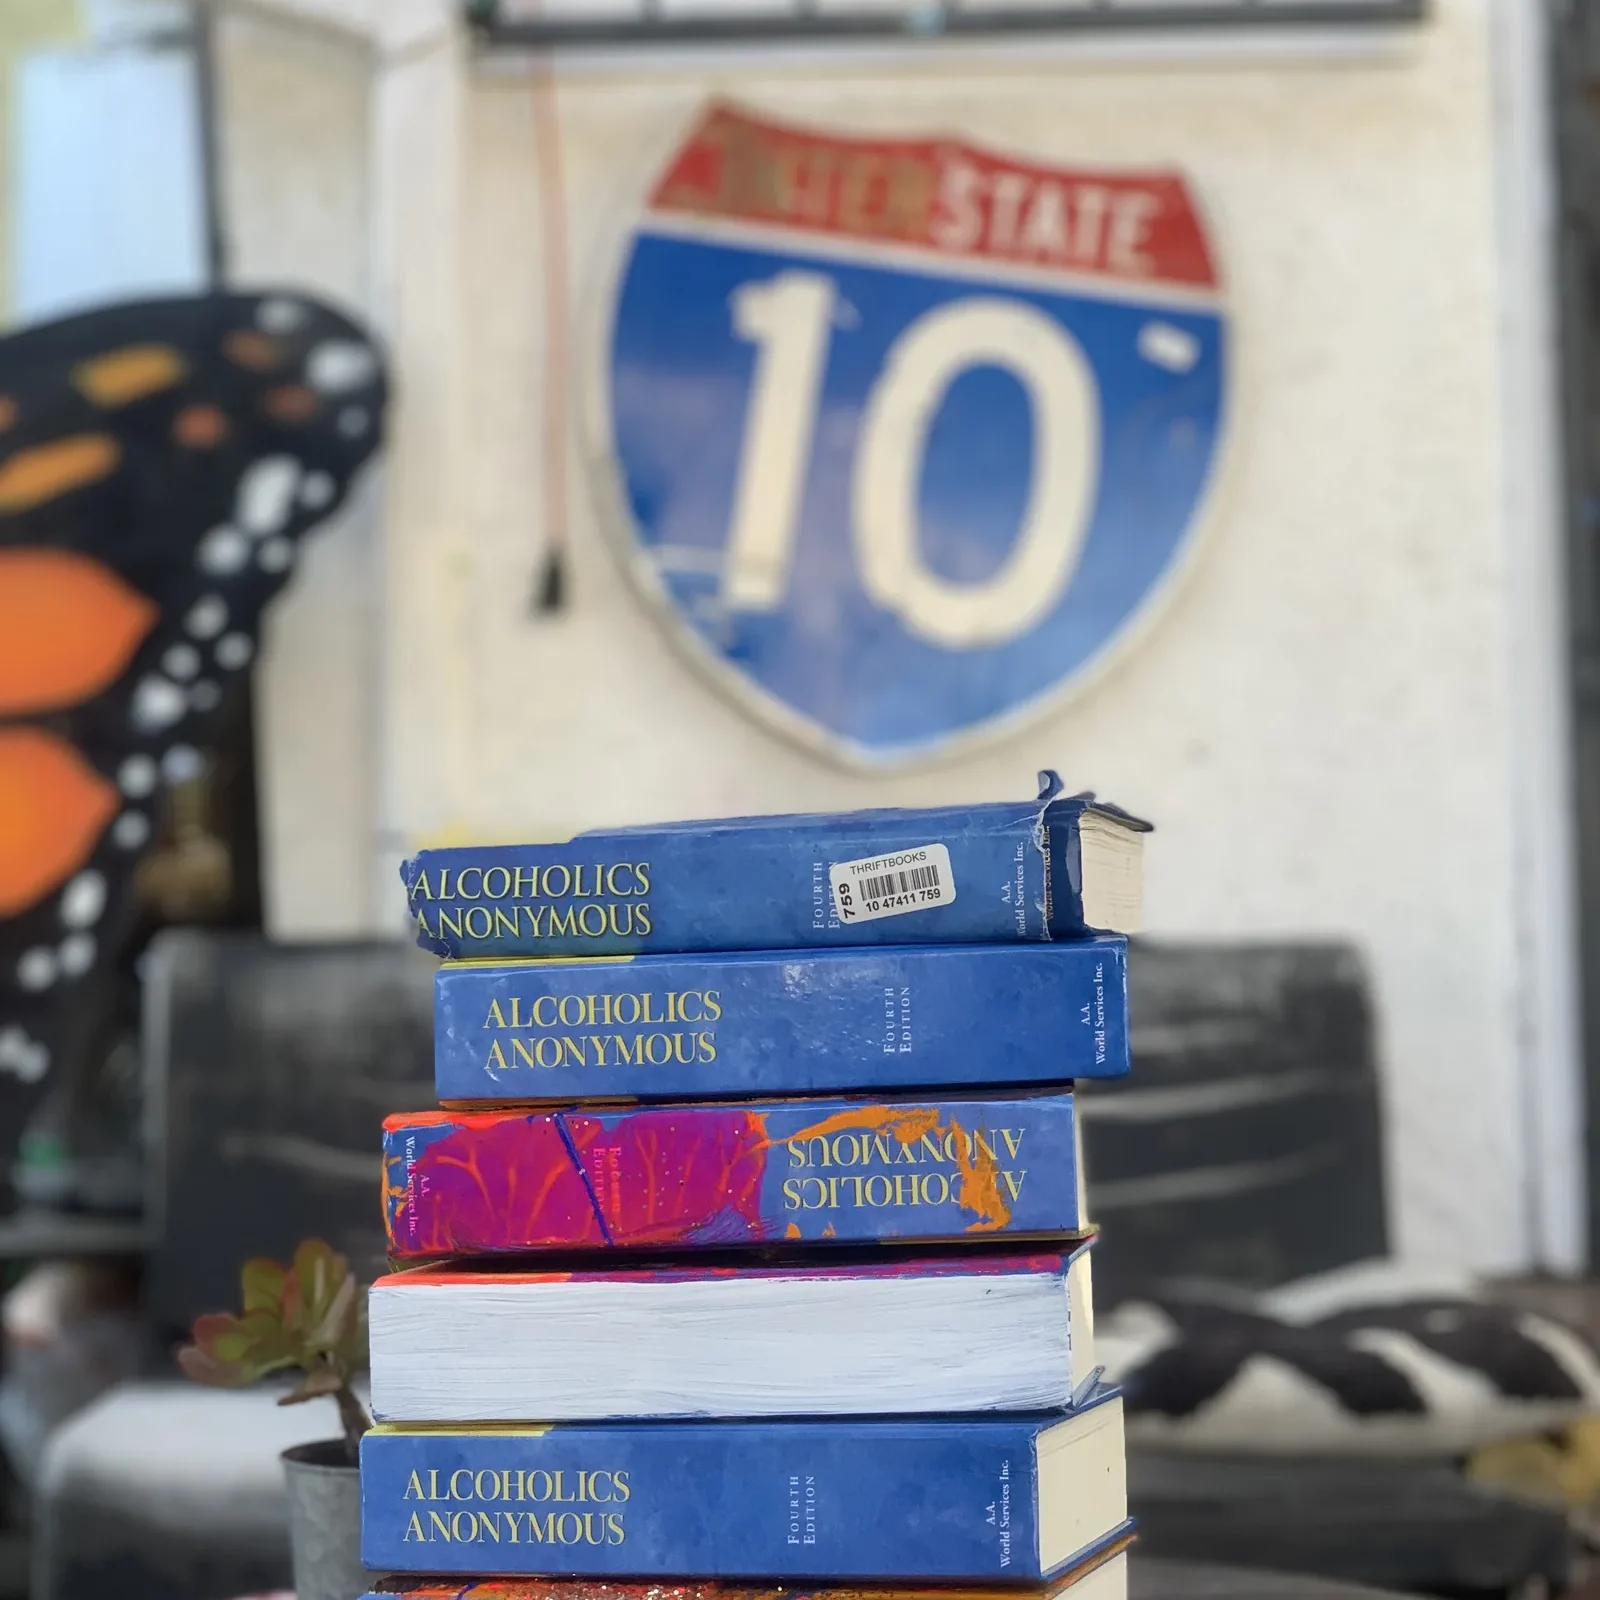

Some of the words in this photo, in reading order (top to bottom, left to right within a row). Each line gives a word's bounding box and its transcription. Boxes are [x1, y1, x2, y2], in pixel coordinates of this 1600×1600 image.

[728, 270, 1101, 650] 10
[849, 851, 927, 875] THRIFTBOOKS
[1013, 841, 1024, 862] Inc.
[410, 862, 651, 901] ALCOHOLICS
[812, 861, 825, 929] FOURTH
[1001, 881, 1011, 904] A.A.
[1014, 865, 1025, 907] Services
[837, 883, 856, 918] 759
[865, 901, 881, 913] 10
[882, 893, 917, 908] 47411
[919, 888, 941, 902] 759
[417, 903, 652, 939] ANONYMOUS
[1093, 962, 1103, 984] Inc.
[482, 990, 722, 1029] ALCOHOLICS
[883, 986, 896, 1054] FOURTH
[900, 986, 912, 1053] EDITION
[1081, 1002, 1091, 1025] A.A.
[1094, 986, 1105, 1028] Services
[484, 1031, 717, 1069] ANONYMOUS
[1094, 1031, 1106, 1065] World
[405, 1136, 417, 1170] World
[787, 1128, 1026, 1168] ANONYMOUS
[407, 1172, 418, 1213] Services
[420, 1174, 431, 1197] A.A.
[409, 1216, 419, 1236] Inc.
[402, 1469, 631, 1502] ALCOHOLICS
[999, 1459, 1010, 1481] Inc.
[788, 1476, 800, 1545] FOURTH
[804, 1475, 816, 1545] EDITION
[985, 1500, 996, 1526] A.A.
[1000, 1484, 1011, 1529] Services
[403, 1511, 625, 1545] ANONYMOUS
[1000, 1531, 1011, 1568] World
